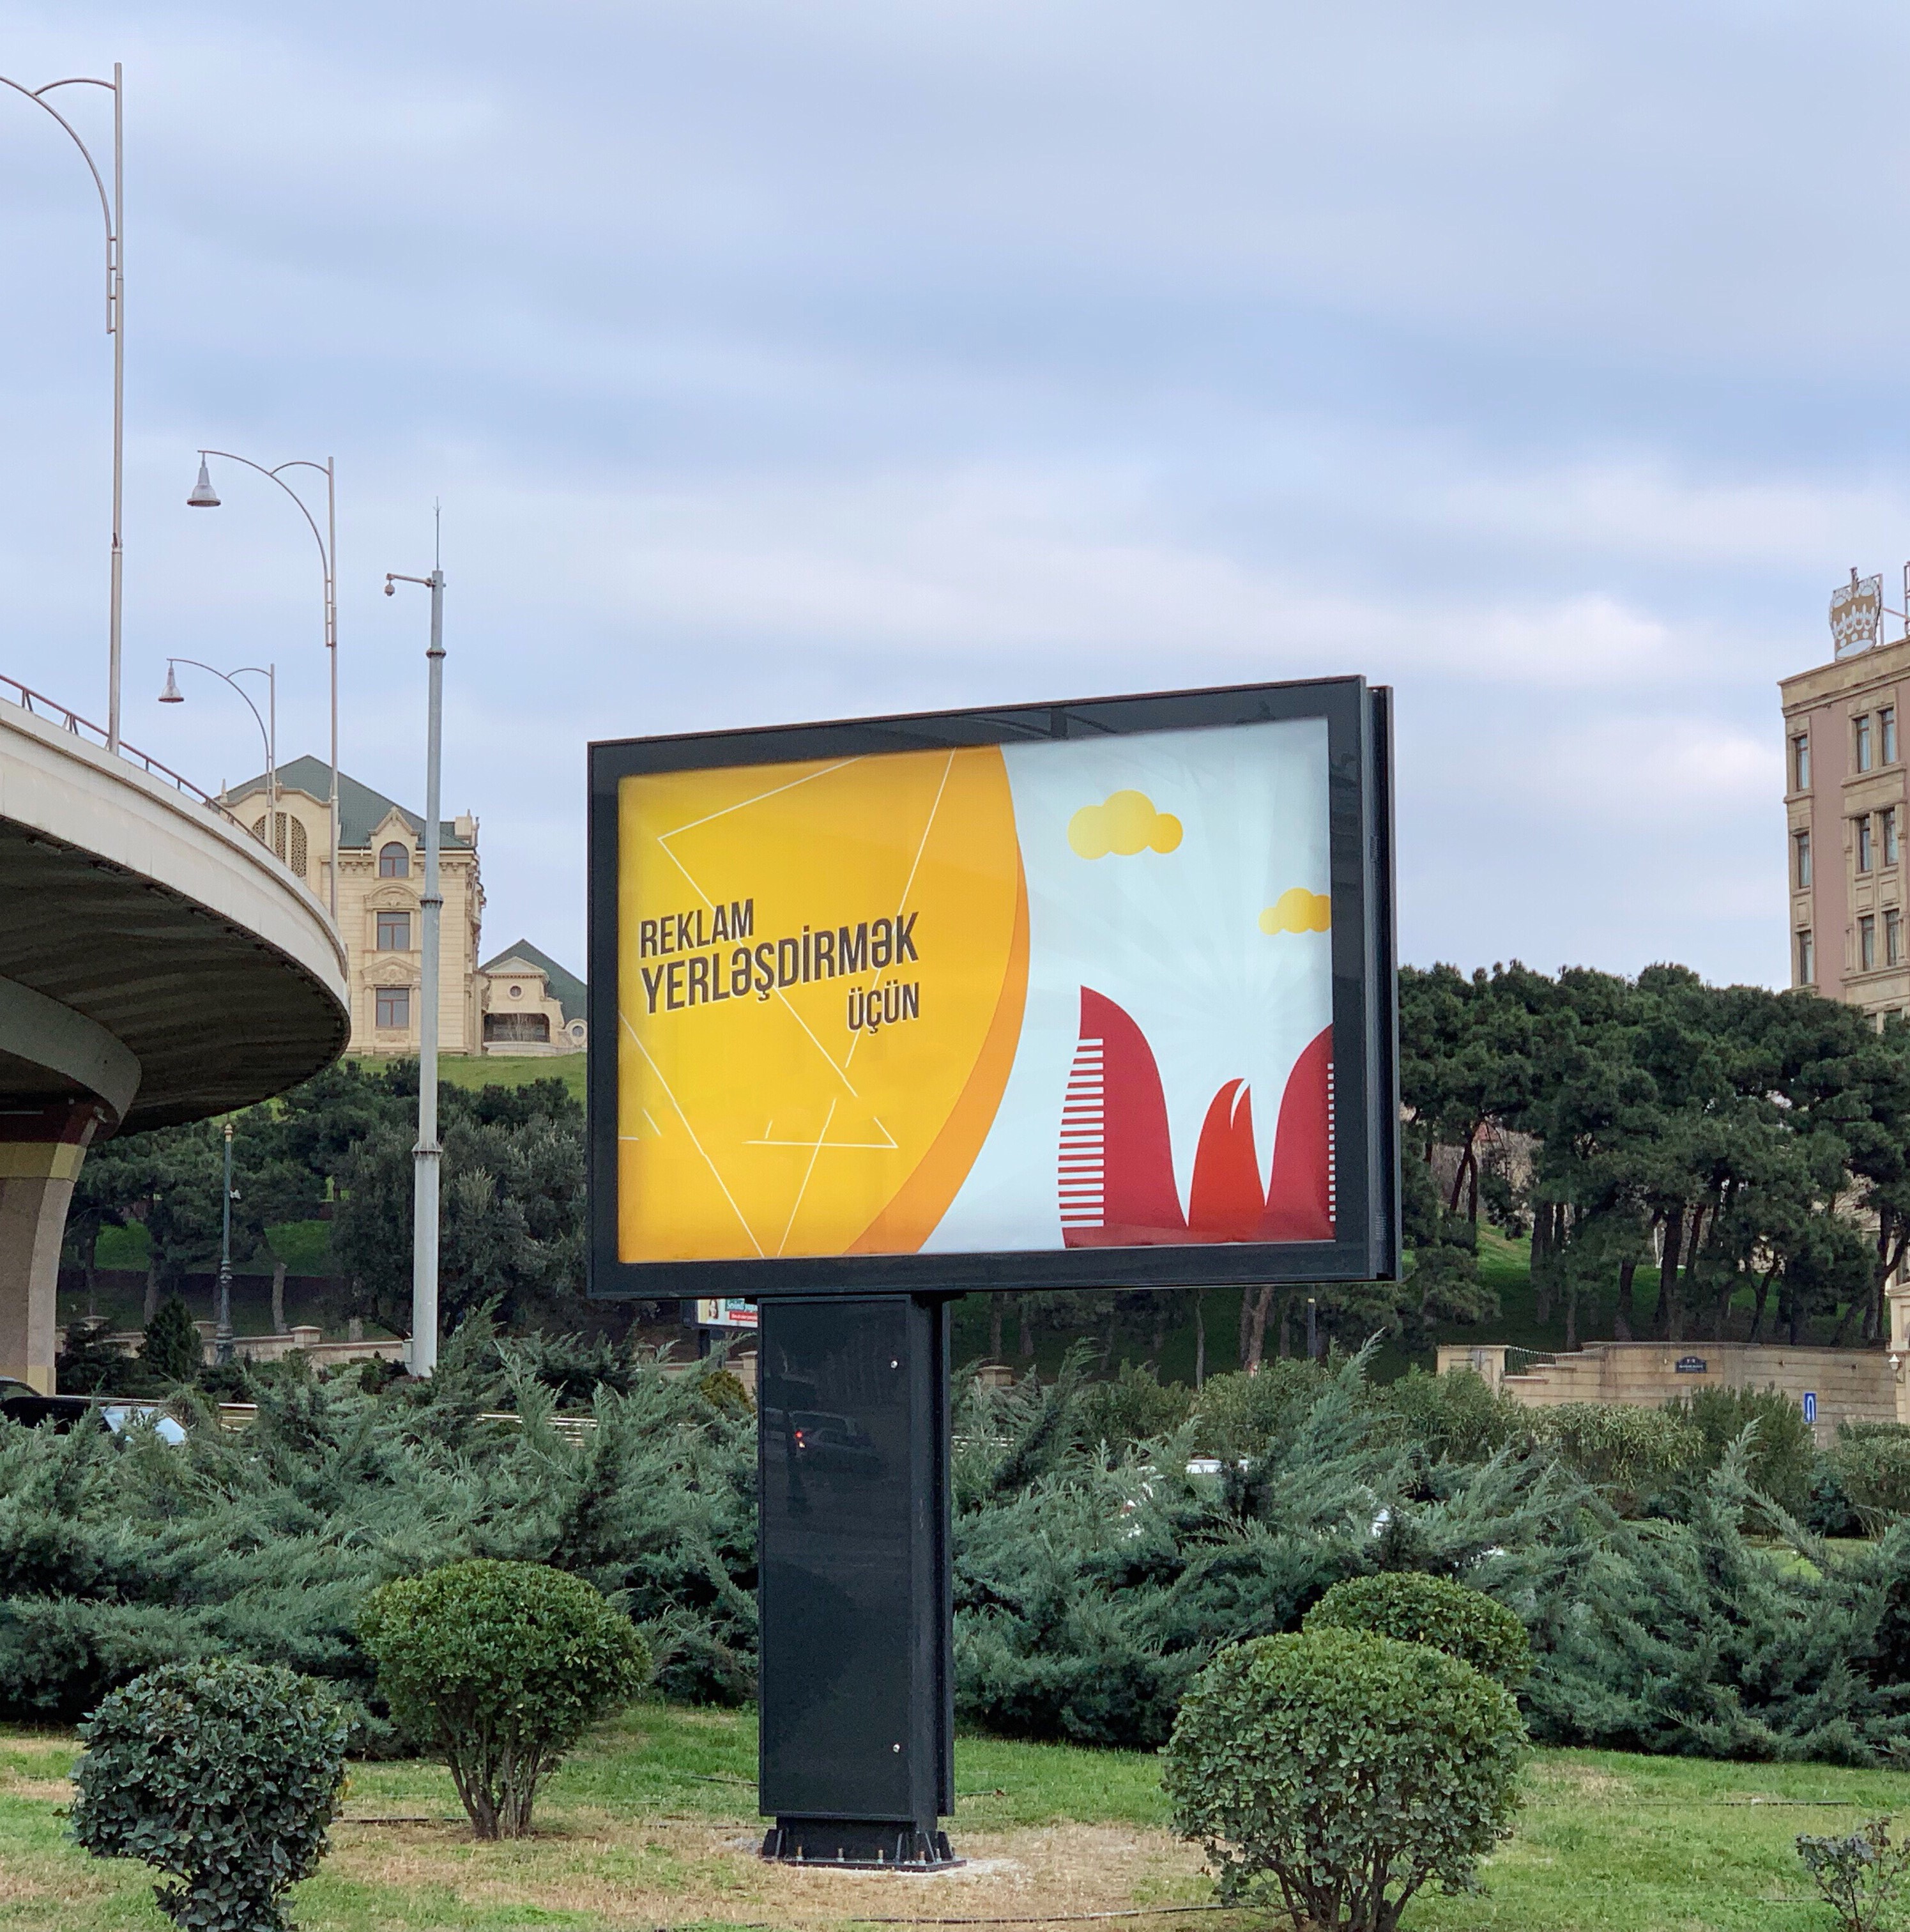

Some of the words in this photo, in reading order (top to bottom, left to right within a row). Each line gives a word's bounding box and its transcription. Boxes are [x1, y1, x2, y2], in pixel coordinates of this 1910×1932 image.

[640, 898, 754, 958] REKLAM
[641, 912, 919, 1014] YERLƏŞDİRMƏK
[848, 979, 919, 1034] ÜÇÜN
